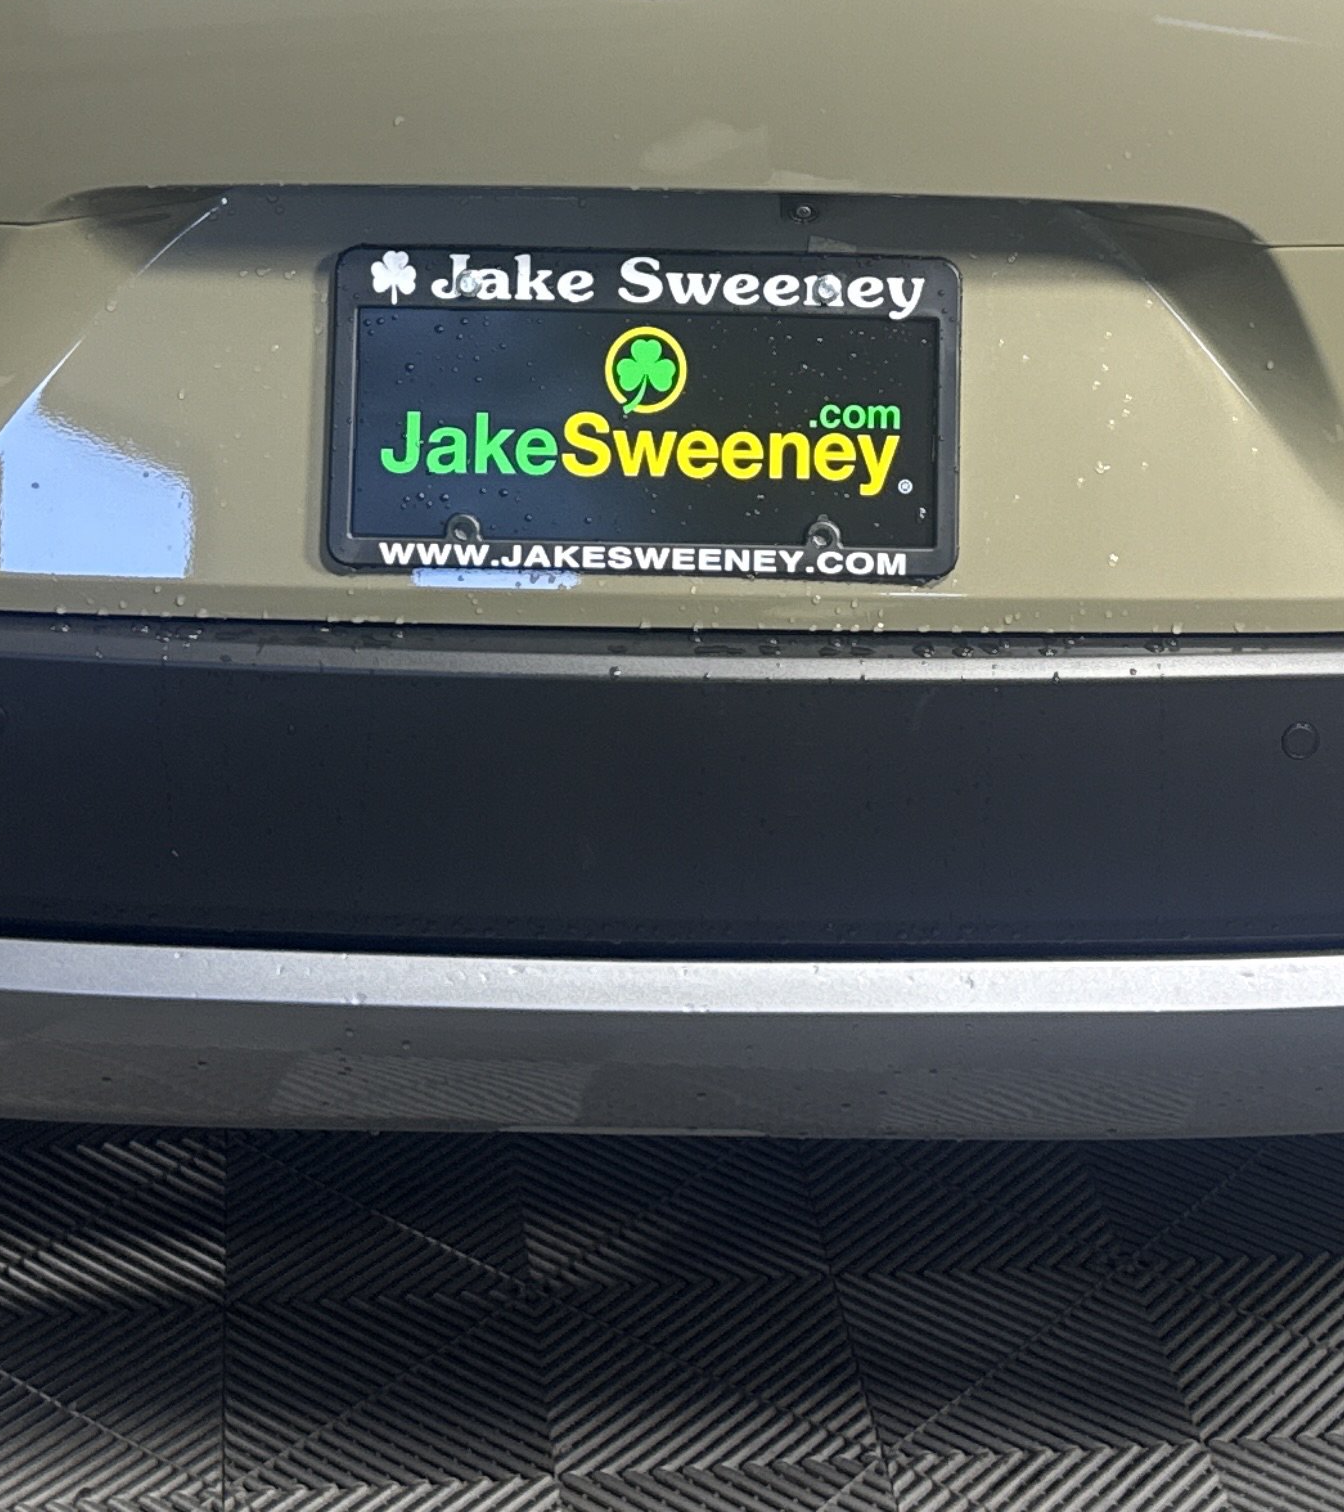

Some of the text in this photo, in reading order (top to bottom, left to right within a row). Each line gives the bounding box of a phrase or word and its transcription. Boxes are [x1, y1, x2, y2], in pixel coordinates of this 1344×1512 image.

[431, 253, 926, 320] Jake Sweeney
[808, 404, 901, 430] .com
[378, 541, 908, 577] WWW.JAKESWEENEY.COM
